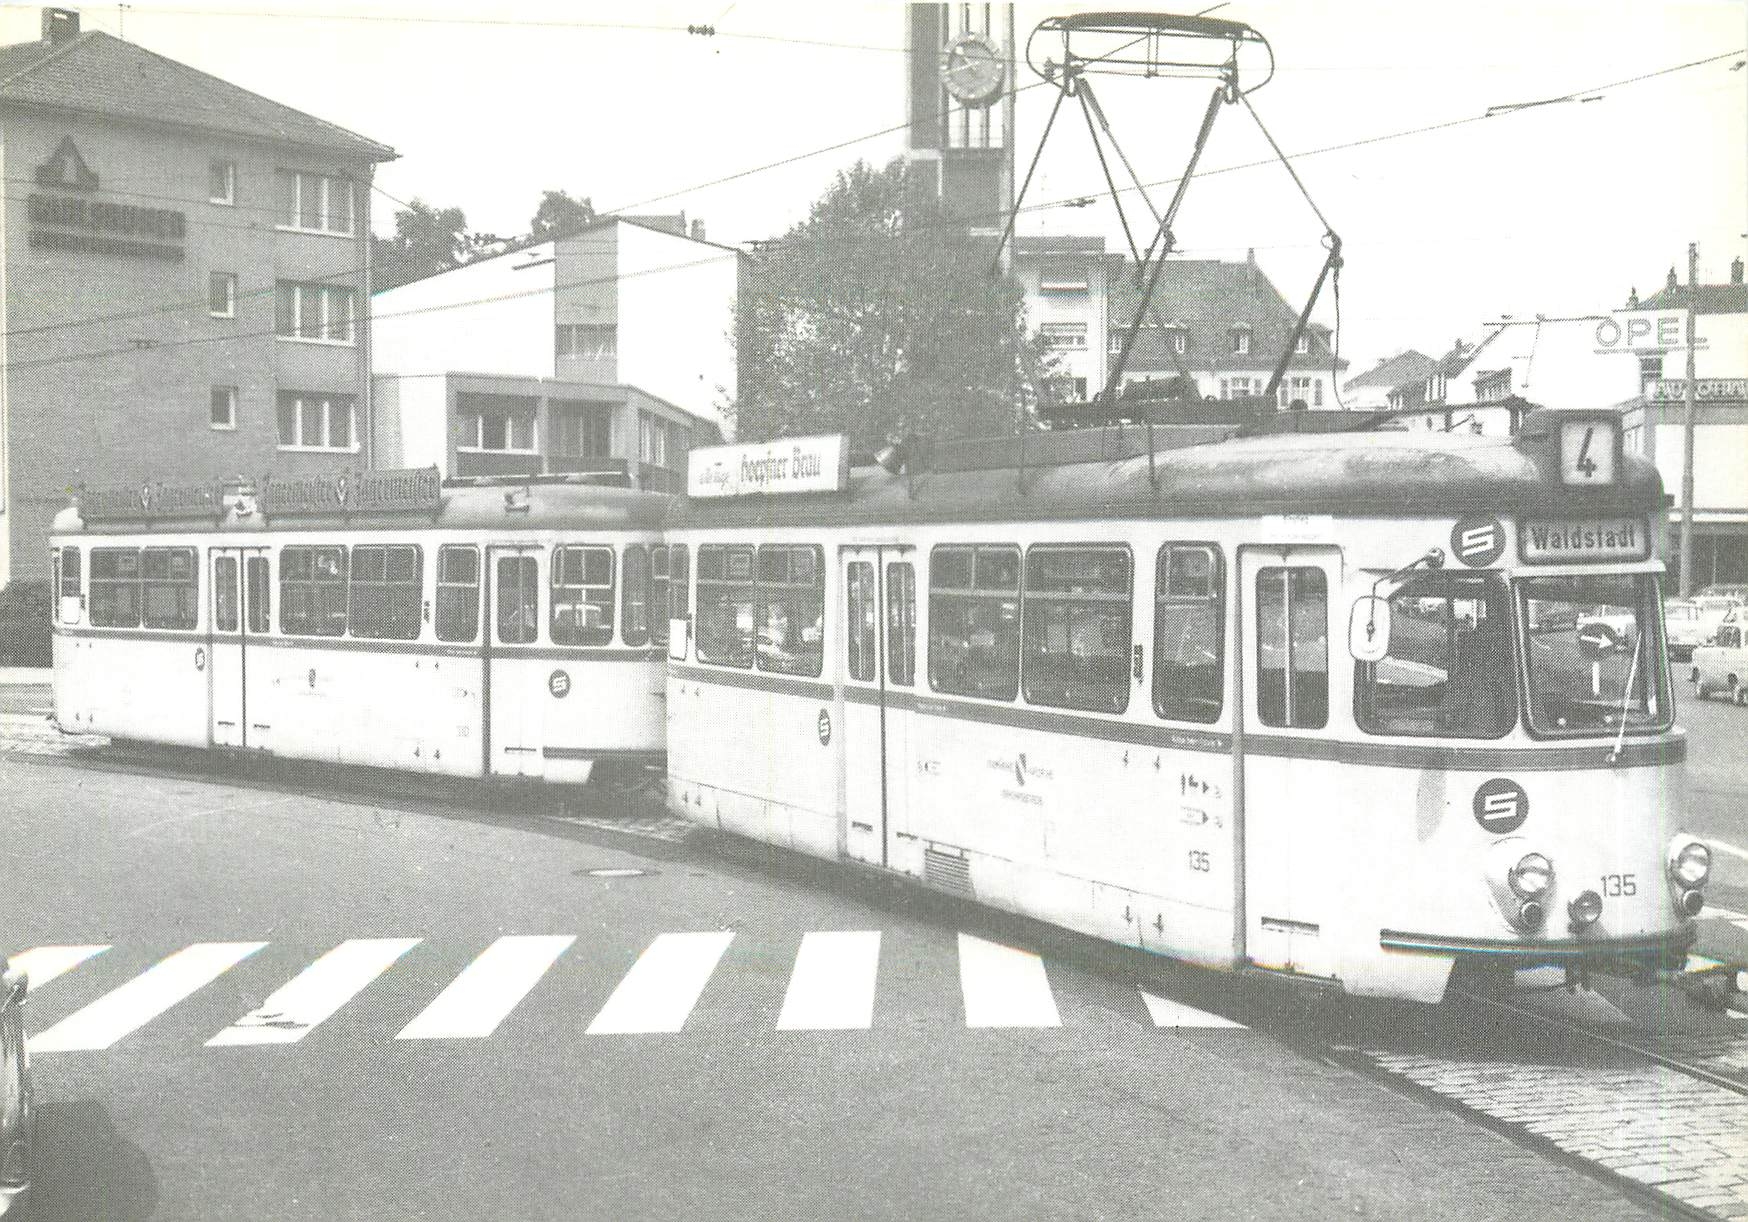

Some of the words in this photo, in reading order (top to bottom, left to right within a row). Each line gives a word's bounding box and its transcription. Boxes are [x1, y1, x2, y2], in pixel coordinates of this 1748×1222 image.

[1576, 426, 1599, 478] 4
[1532, 523, 1635, 551] Waldstadt
[1188, 849, 1211, 873] 135
[1600, 873, 1637, 898] 135
